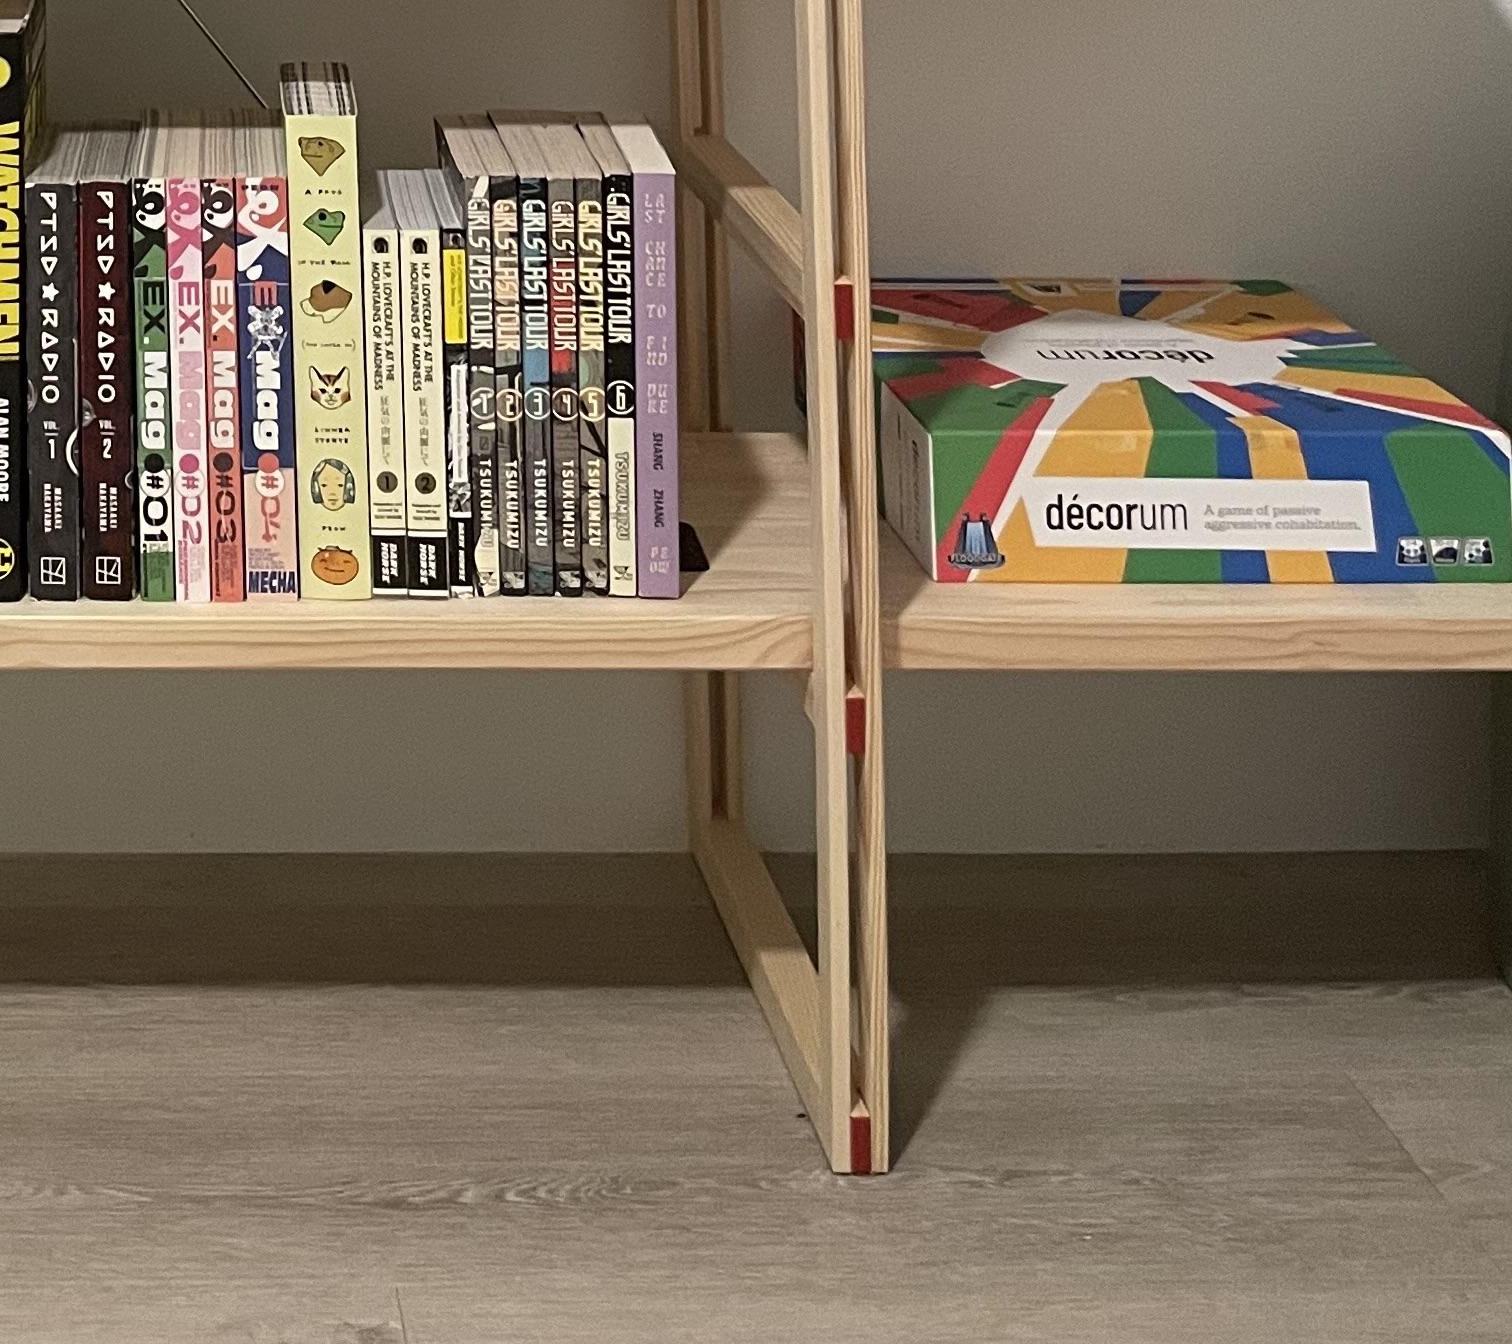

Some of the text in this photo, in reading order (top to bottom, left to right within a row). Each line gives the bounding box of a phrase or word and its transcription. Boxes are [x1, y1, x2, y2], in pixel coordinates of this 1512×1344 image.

[98, 192, 115, 403] PTSD RADIO
[139, 352, 170, 450] Mag
[534, 459, 547, 547] TSUKUMIZU
[1046, 494, 1188, 531] décorum
